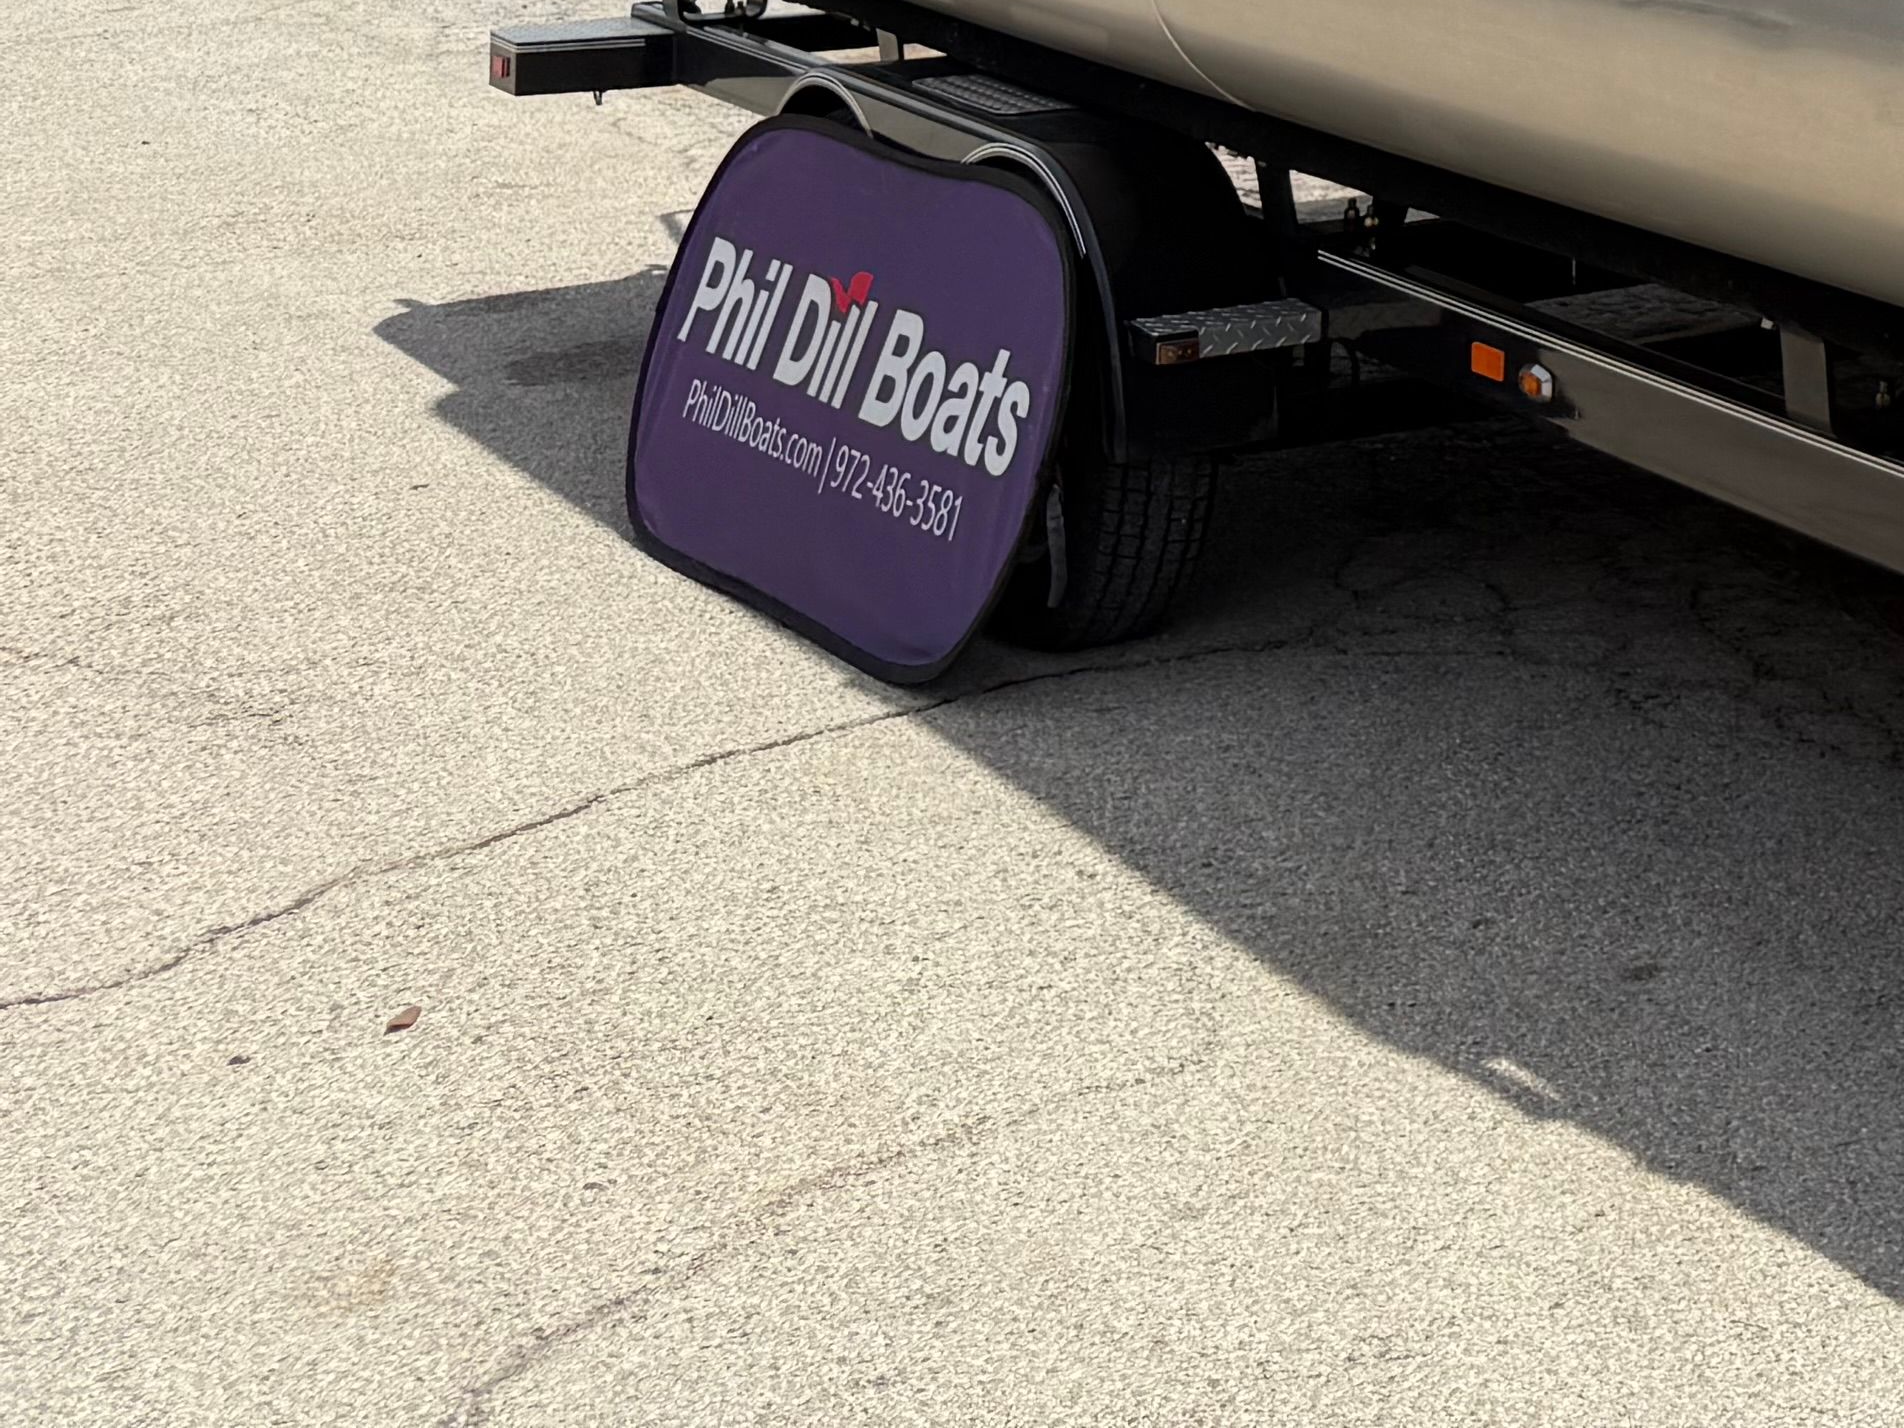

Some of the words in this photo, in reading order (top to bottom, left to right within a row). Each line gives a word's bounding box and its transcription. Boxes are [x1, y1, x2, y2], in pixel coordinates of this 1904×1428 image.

[677, 236, 793, 371] Phil
[772, 271, 878, 410] Dill
[857, 309, 1030, 477] Boats
[682, 378, 822, 478] PhilDillBoats.com
[829, 445, 964, 542] 972-436-3581
